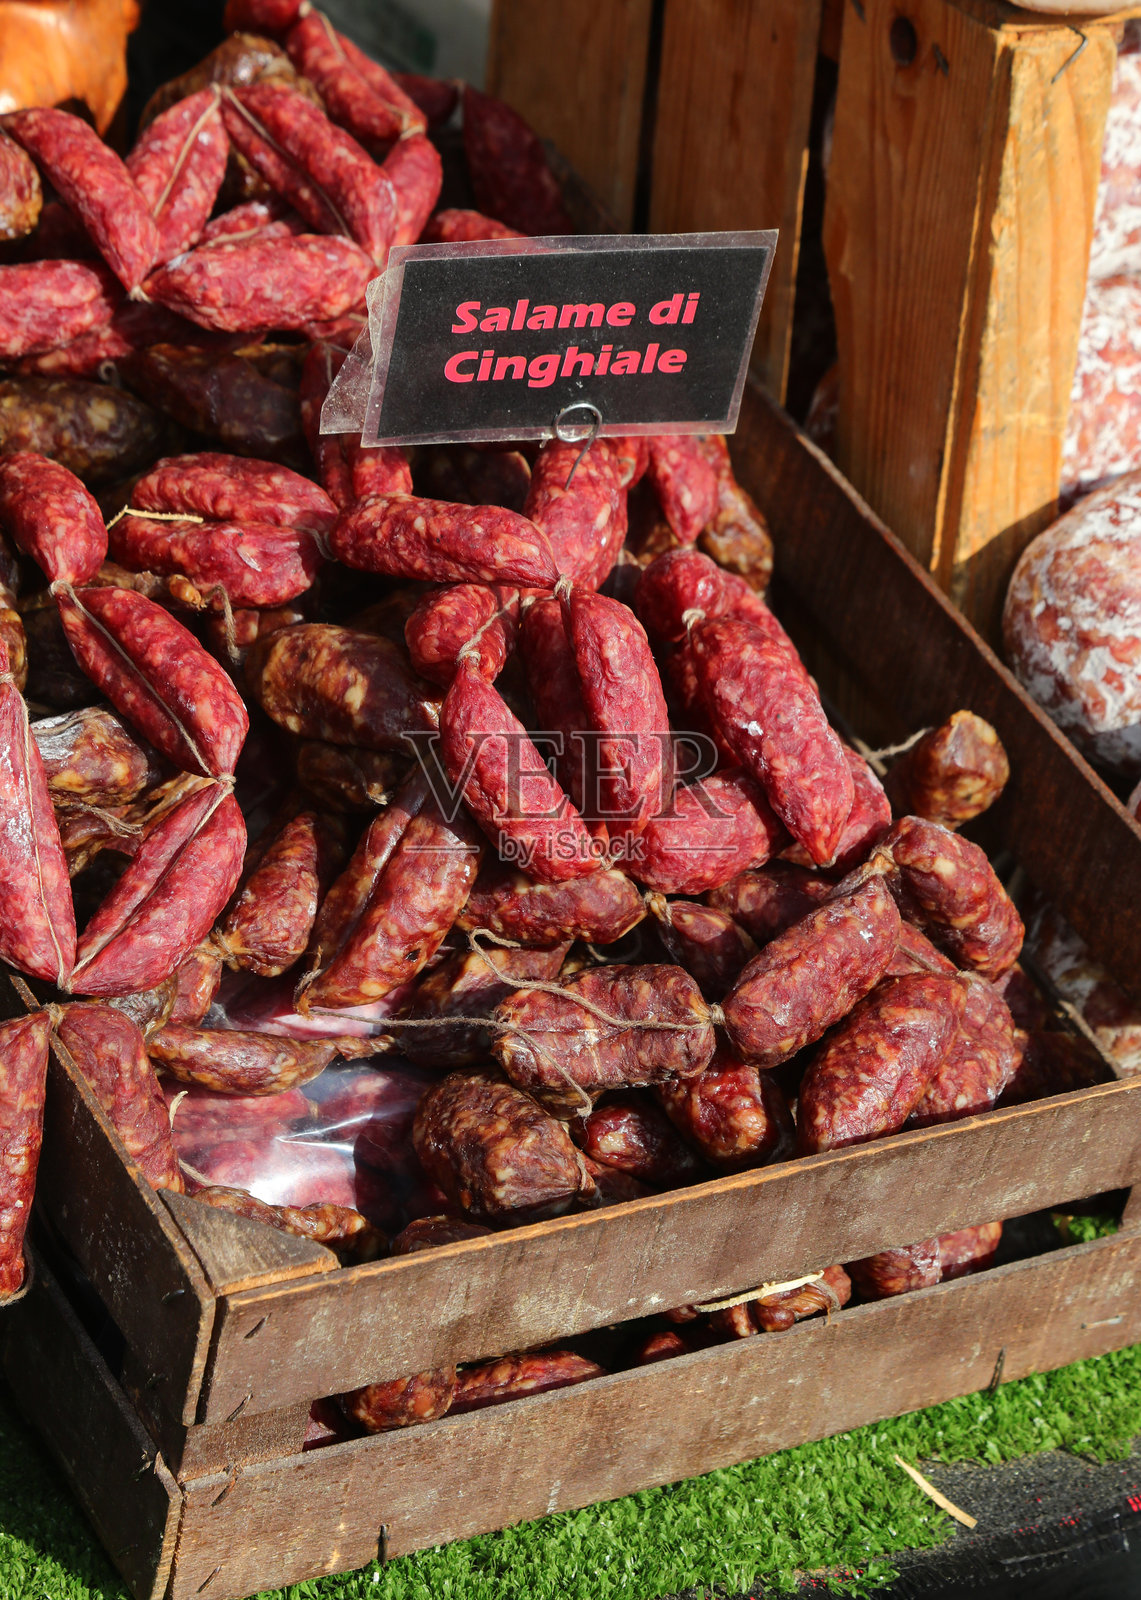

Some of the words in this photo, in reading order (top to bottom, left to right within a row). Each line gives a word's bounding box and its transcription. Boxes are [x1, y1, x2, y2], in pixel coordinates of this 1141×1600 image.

[450, 299, 637, 335] Salame
[648, 292, 701, 327] di
[443, 342, 688, 389] Cinghiale
